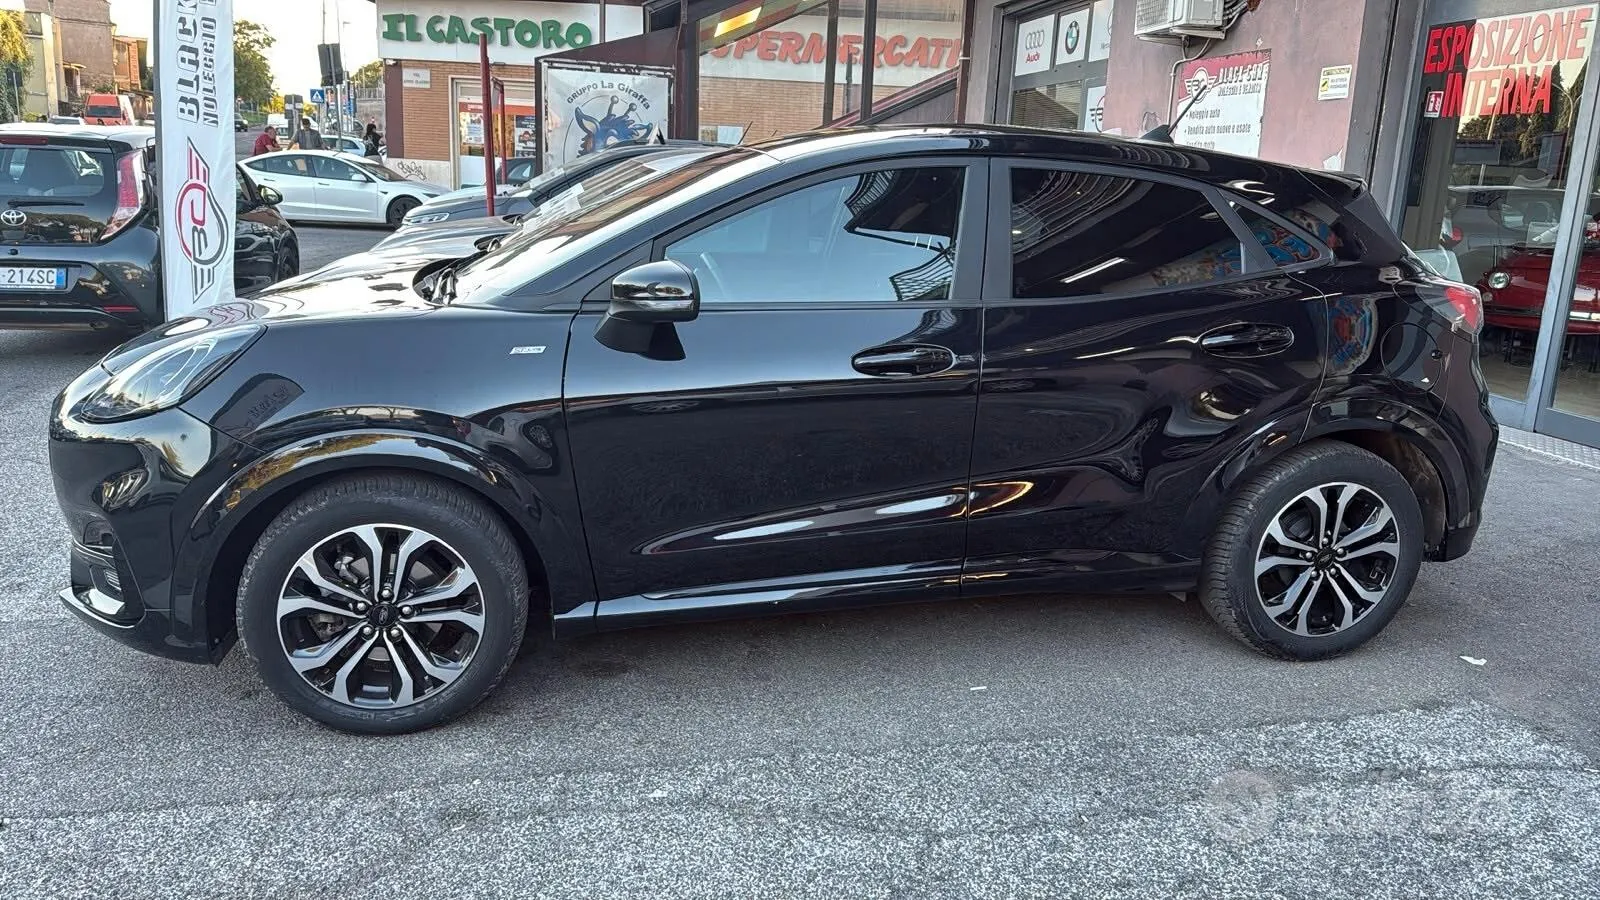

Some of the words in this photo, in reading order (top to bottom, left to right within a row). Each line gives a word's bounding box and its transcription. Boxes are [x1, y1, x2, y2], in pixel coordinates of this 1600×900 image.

[382, 13, 422, 42] IL
[426, 15, 592, 48] CASTORO
[1424, 7, 1593, 74] ESPOSIZIONE
[200, 16, 219, 128] NOLEGGIO
[1025, 52, 1040, 63] Audi
[567, 83, 598, 104] GRUPPO
[601, 80, 614, 89] La
[617, 82, 651, 110] Giraffa
[1441, 65, 1553, 118] INTERNA
[7, 268, 55, 284] 214SC
